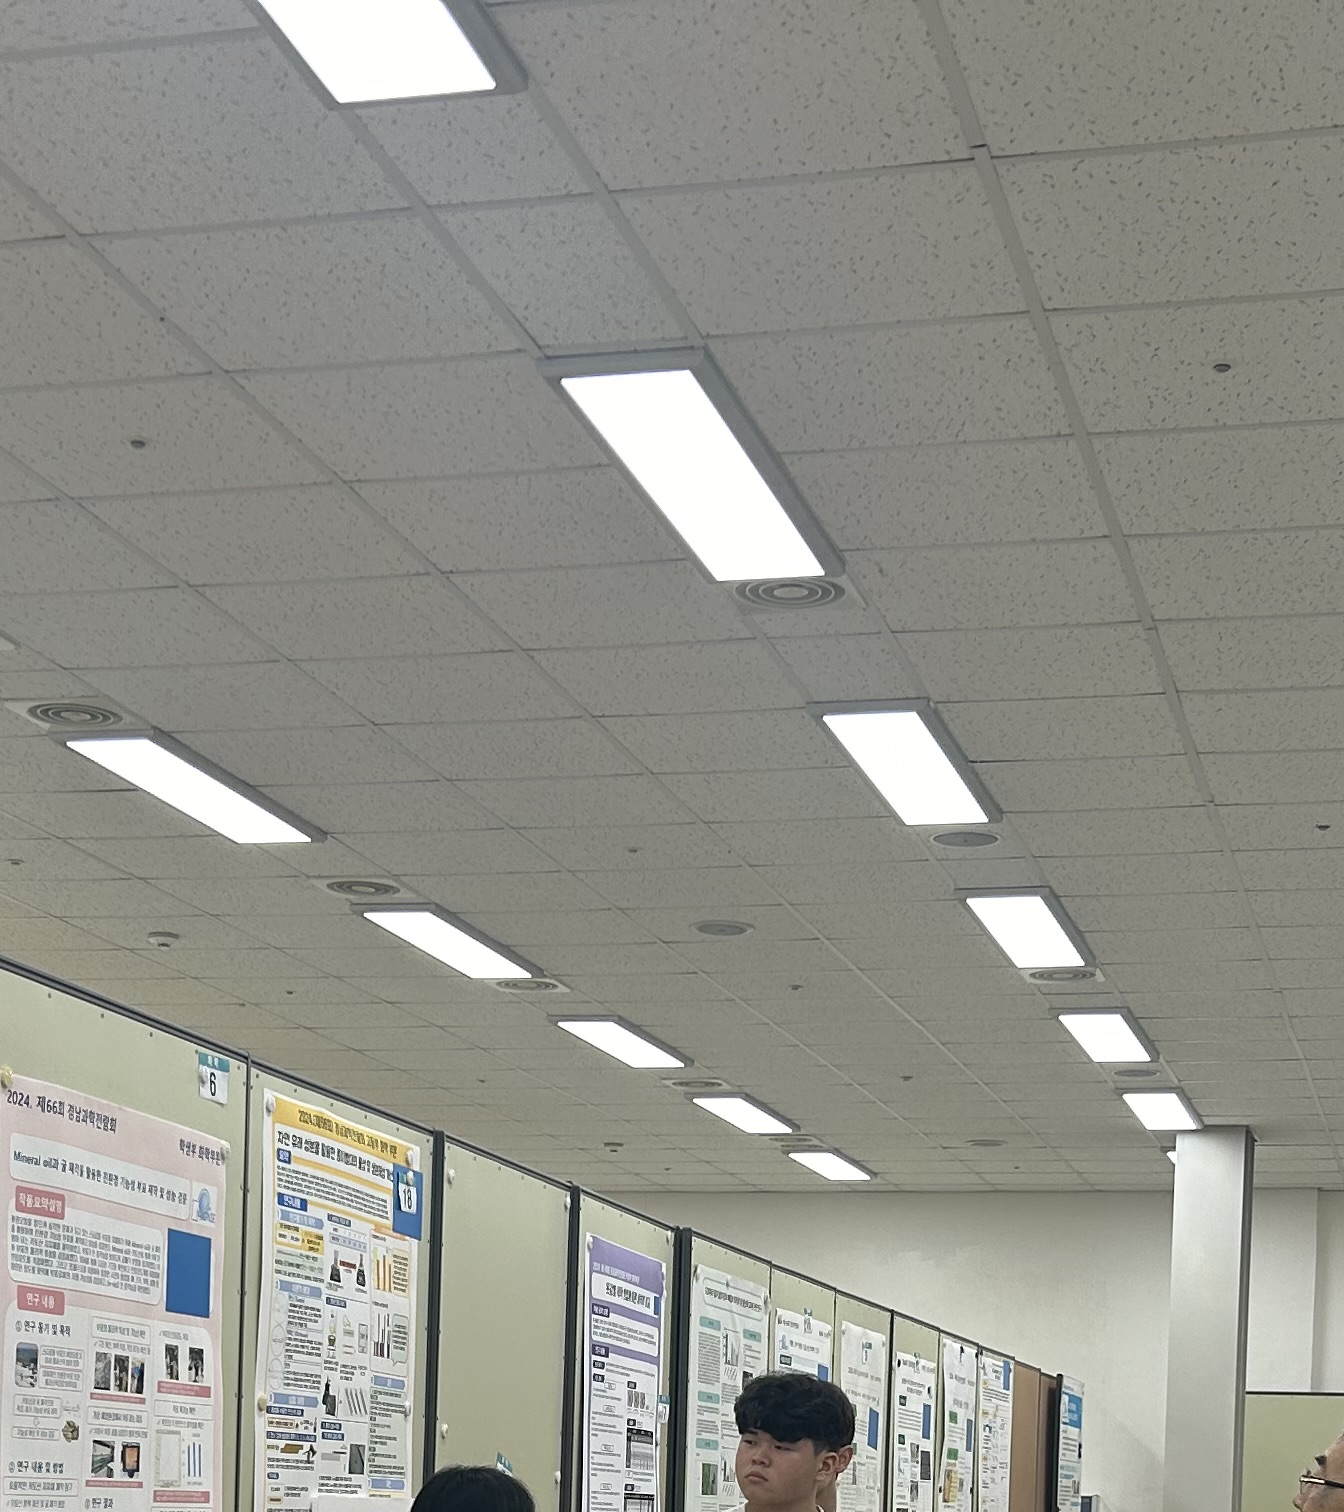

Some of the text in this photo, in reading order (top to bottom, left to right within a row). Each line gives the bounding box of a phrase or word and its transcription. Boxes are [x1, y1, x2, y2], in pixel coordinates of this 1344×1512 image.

[209, 1072, 217, 1097] 6
[7, 1089, 117, 1134] 2024. 제66회 경남과학전람회
[13, 1150, 41, 1167] Mineral
[402, 1187, 413, 1210] 18
[26, 1292, 39, 1306] 연구
[24, 1320, 36, 1333] 연구
